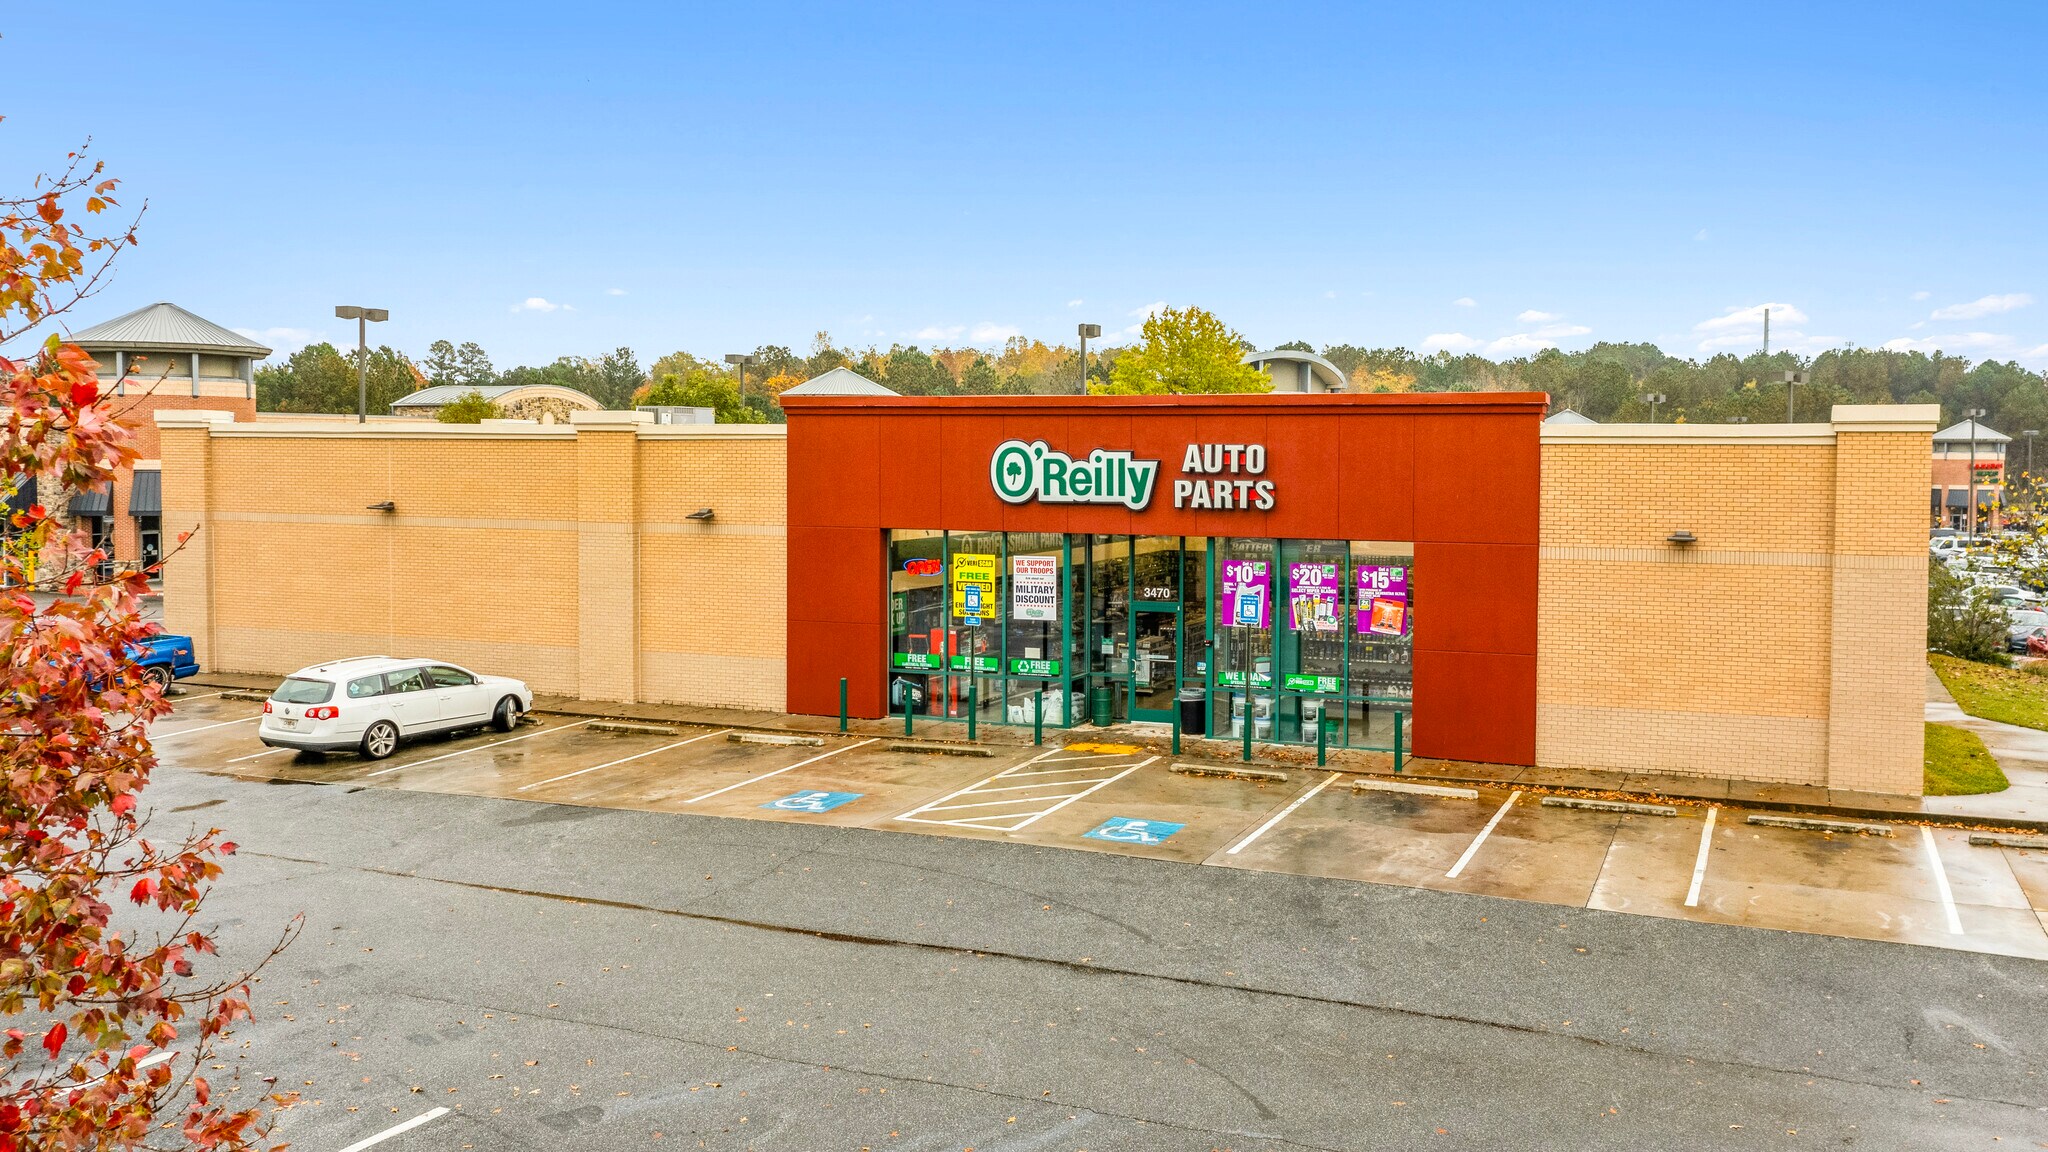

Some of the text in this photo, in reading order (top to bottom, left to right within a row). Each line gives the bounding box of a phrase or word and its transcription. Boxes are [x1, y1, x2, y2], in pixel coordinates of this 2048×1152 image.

[1181, 443, 1266, 475] AUTO
[994, 445, 1152, 504] O'Reilly
[1174, 480, 1275, 510] PARTS
[1232, 542, 1273, 552] BATTERY
[906, 559, 940, 576] OPEN
[959, 572, 990, 580] FREE
[1226, 565, 1253, 583] $10
[1292, 568, 1322, 585] $20
[1362, 570, 1389, 588] $15
[1016, 585, 1054, 594] MILITARY
[1144, 588, 1170, 598] 3470
[1016, 595, 1055, 604] DISCOUNT
[896, 611, 905, 624] UP
[908, 654, 926, 662] FREE
[1031, 660, 1050, 669] FREE
[1225, 672, 1238, 680] WE
